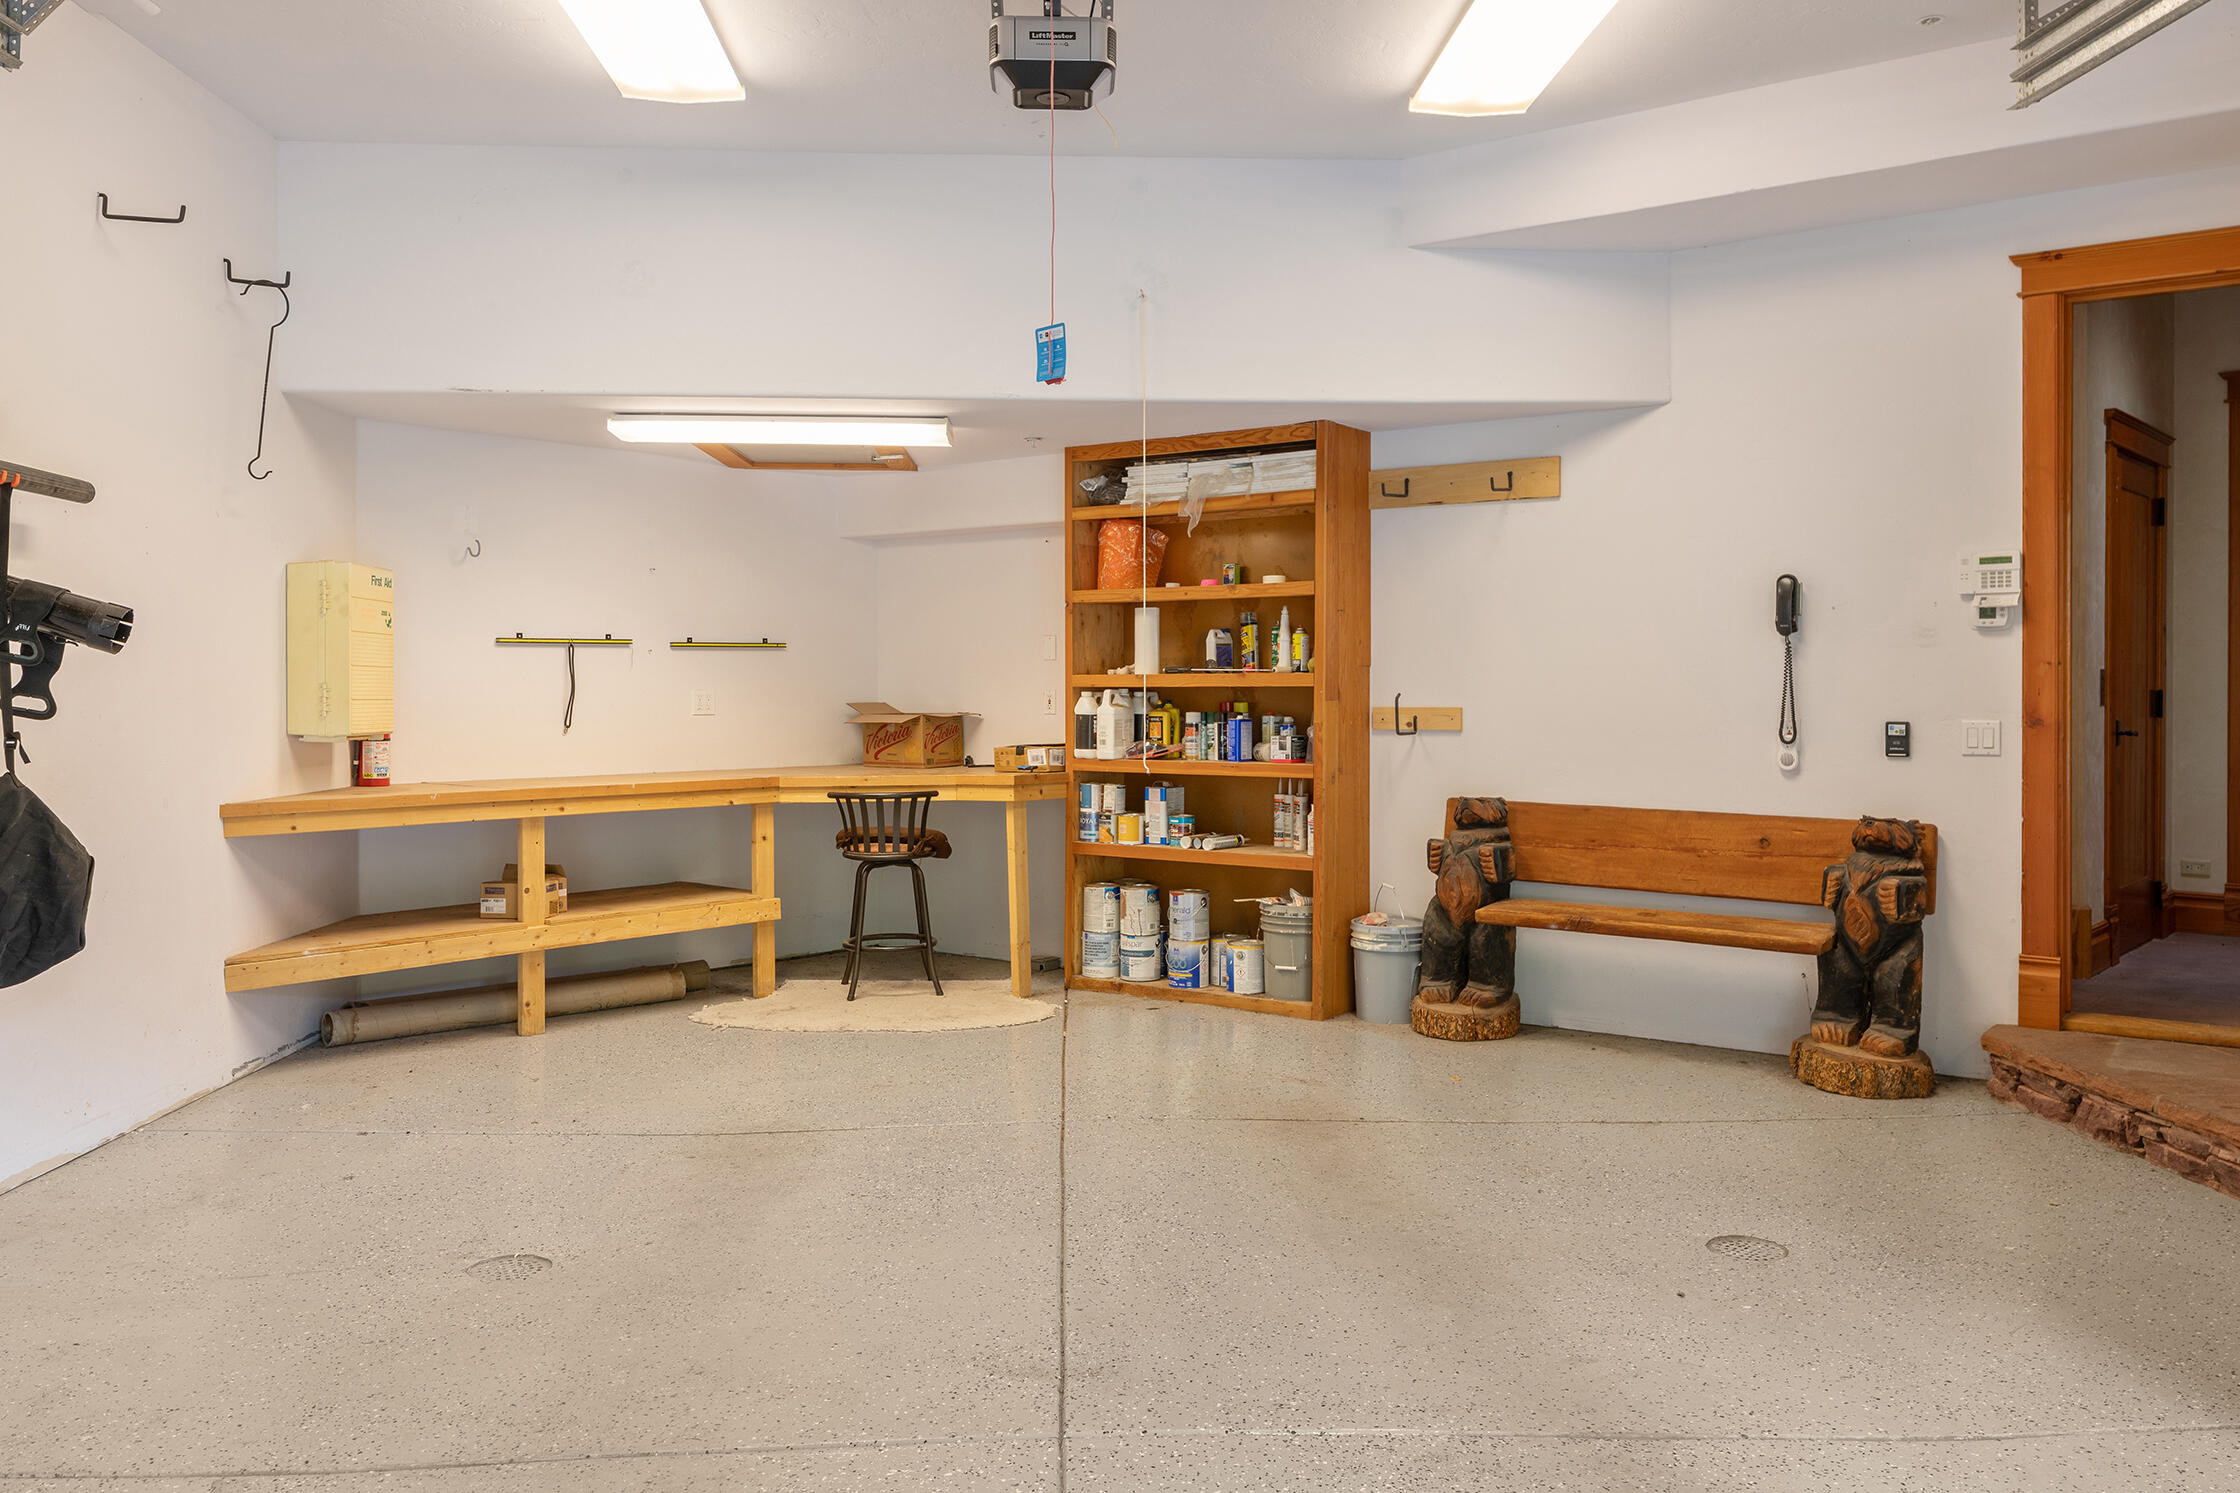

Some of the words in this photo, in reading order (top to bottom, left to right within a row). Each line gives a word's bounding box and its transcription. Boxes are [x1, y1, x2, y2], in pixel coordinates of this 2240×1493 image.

[371, 575, 383, 587] First
[384, 577, 393, 588] Aid
[865, 723, 913, 760] Victoria
[923, 720, 960, 753] Victoria
